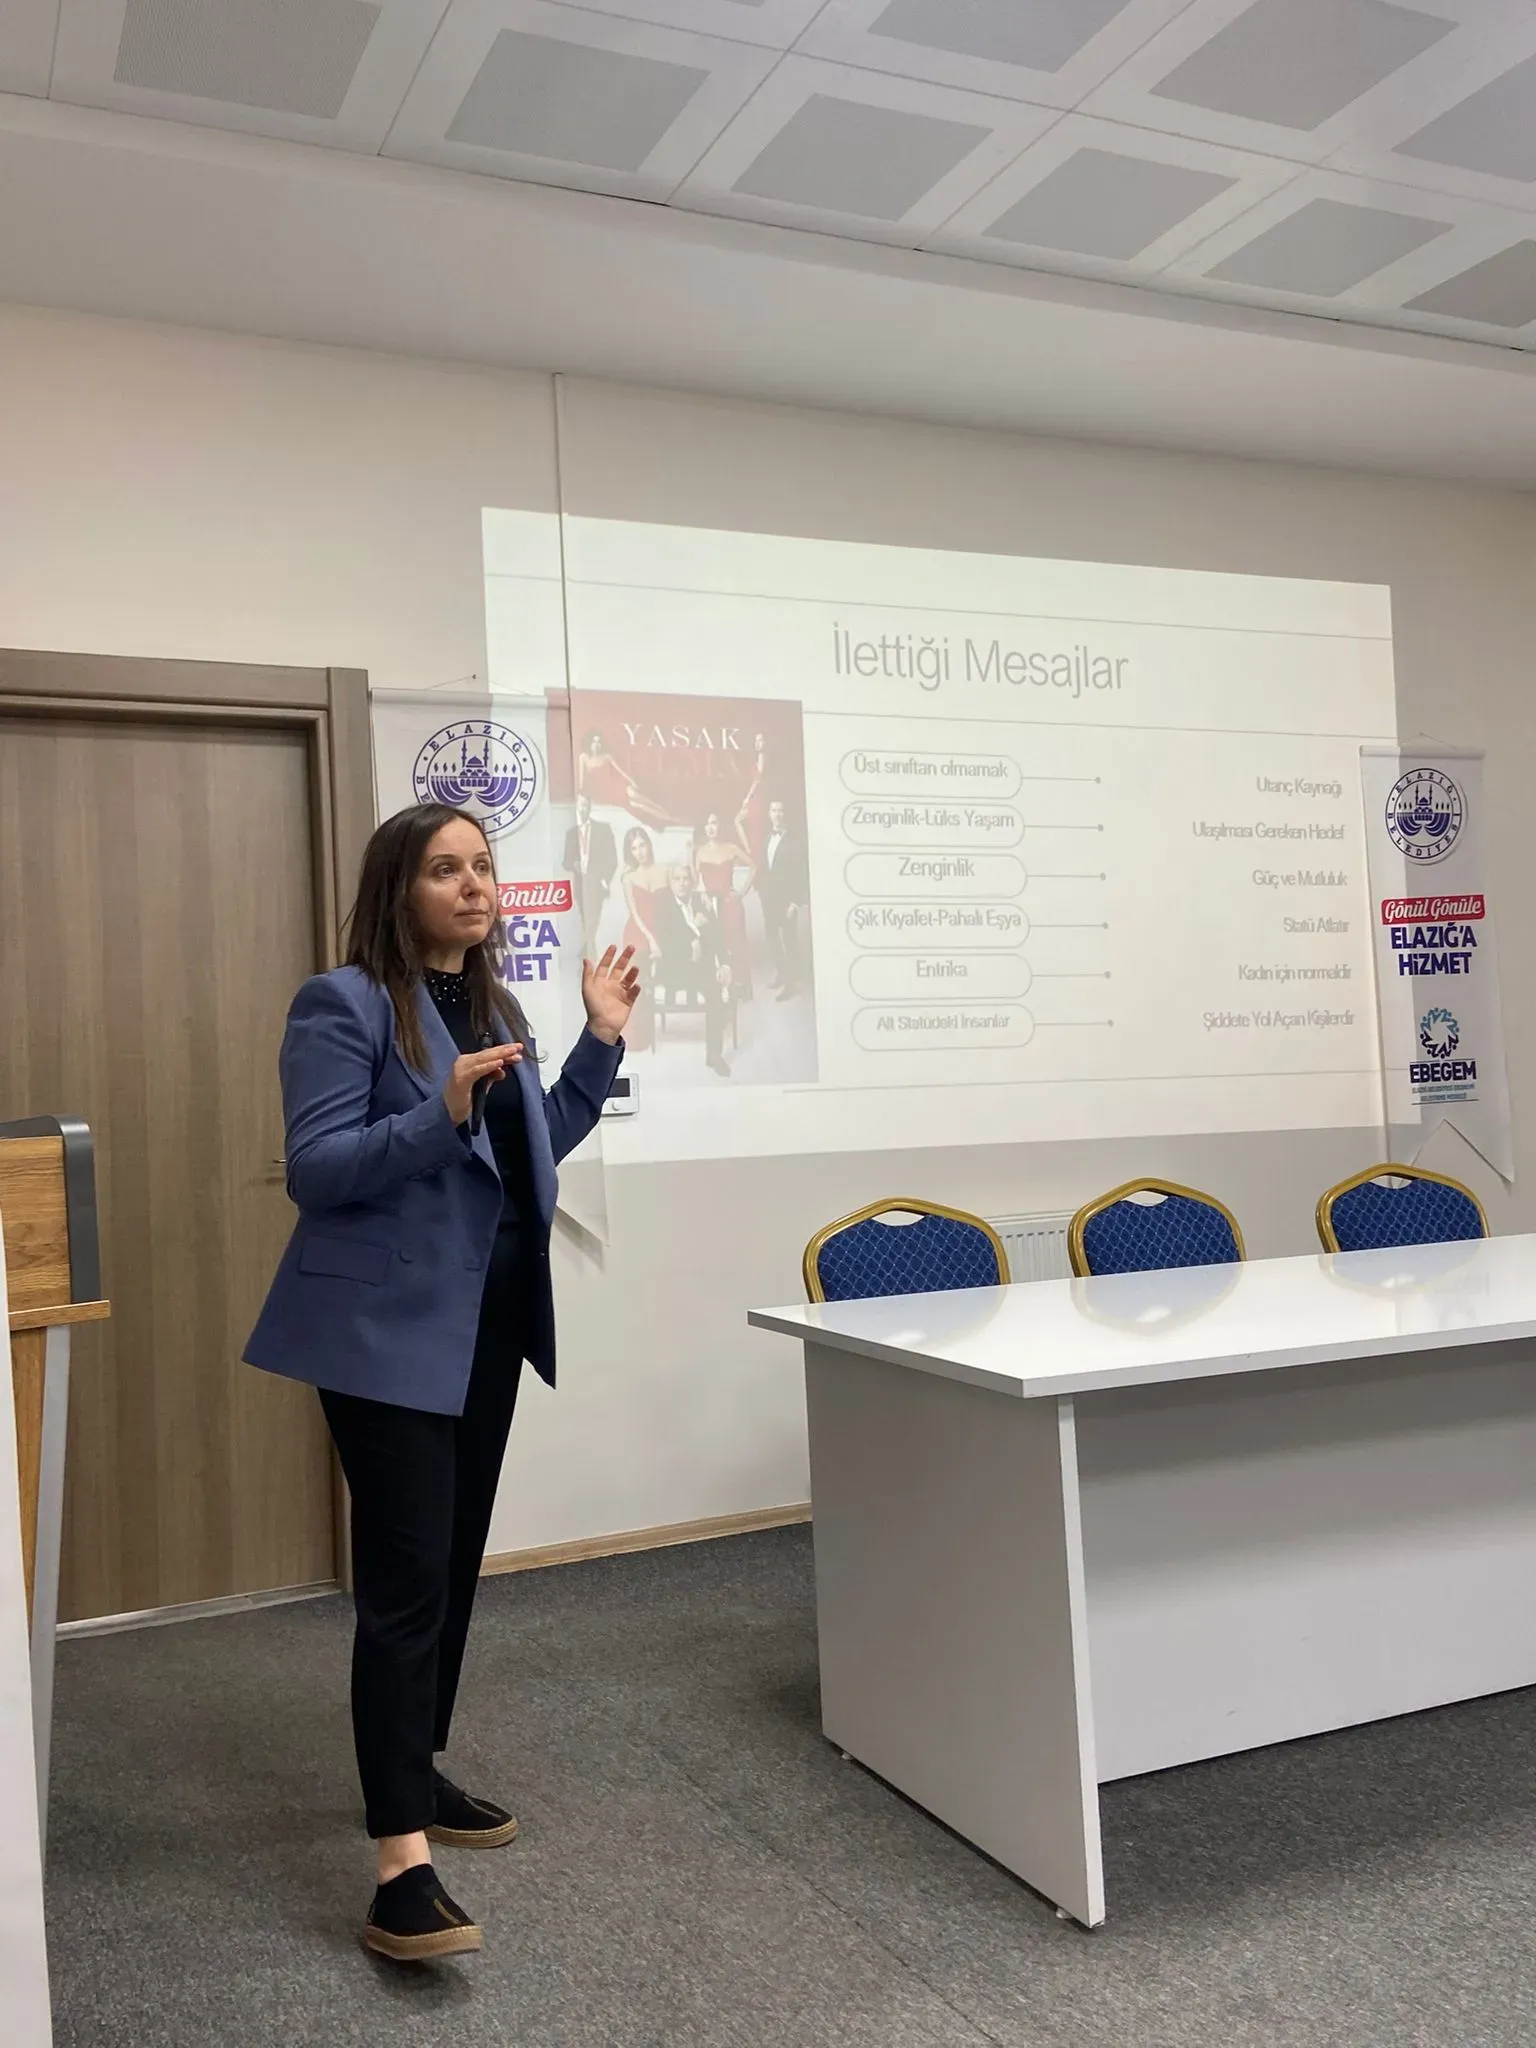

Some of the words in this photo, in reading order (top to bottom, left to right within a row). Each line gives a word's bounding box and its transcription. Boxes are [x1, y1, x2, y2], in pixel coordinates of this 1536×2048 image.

[832, 621, 951, 691] İlettiği
[964, 637, 1129, 699] Mesajlar
[620, 722, 741, 750] YASAK
[854, 752, 881, 774] Üst
[884, 757, 937, 776] sınıftan
[940, 760, 1009, 778] olmamak
[1256, 776, 1293, 796] Utanç
[852, 806, 960, 829] Zenginlik-Lüks
[966, 809, 1015, 831] Yaşam
[1255, 822, 1307, 840] Gereken
[1308, 824, 1346, 840] Hedef
[898, 856, 975, 881] Zenginlik
[1252, 869, 1280, 889] Güç
[1280, 873, 1296, 886] ve
[1298, 870, 1348, 886] Mutluluk
[854, 908, 878, 930] Şık
[882, 909, 983, 930] Kıyafet-Pahalı
[986, 909, 1022, 931] Eşya
[1385, 900, 1429, 922] Gönül
[1431, 895, 1482, 919] Gönüle
[1391, 922, 1477, 949] ELAZIĞ'A
[916, 960, 968, 977] Entrika
[1275, 964, 1296, 983] için
[877, 1017, 895, 1031] Alt
[898, 1014, 958, 1030] Statüdeki
[961, 1012, 1010, 1028] İnsanlar
[1203, 1012, 1250, 1031] Şiddete
[1252, 1011, 1271, 1026] Yol
[1273, 1011, 1306, 1030] Açan
[1409, 1061, 1477, 1083] EBEGEM
